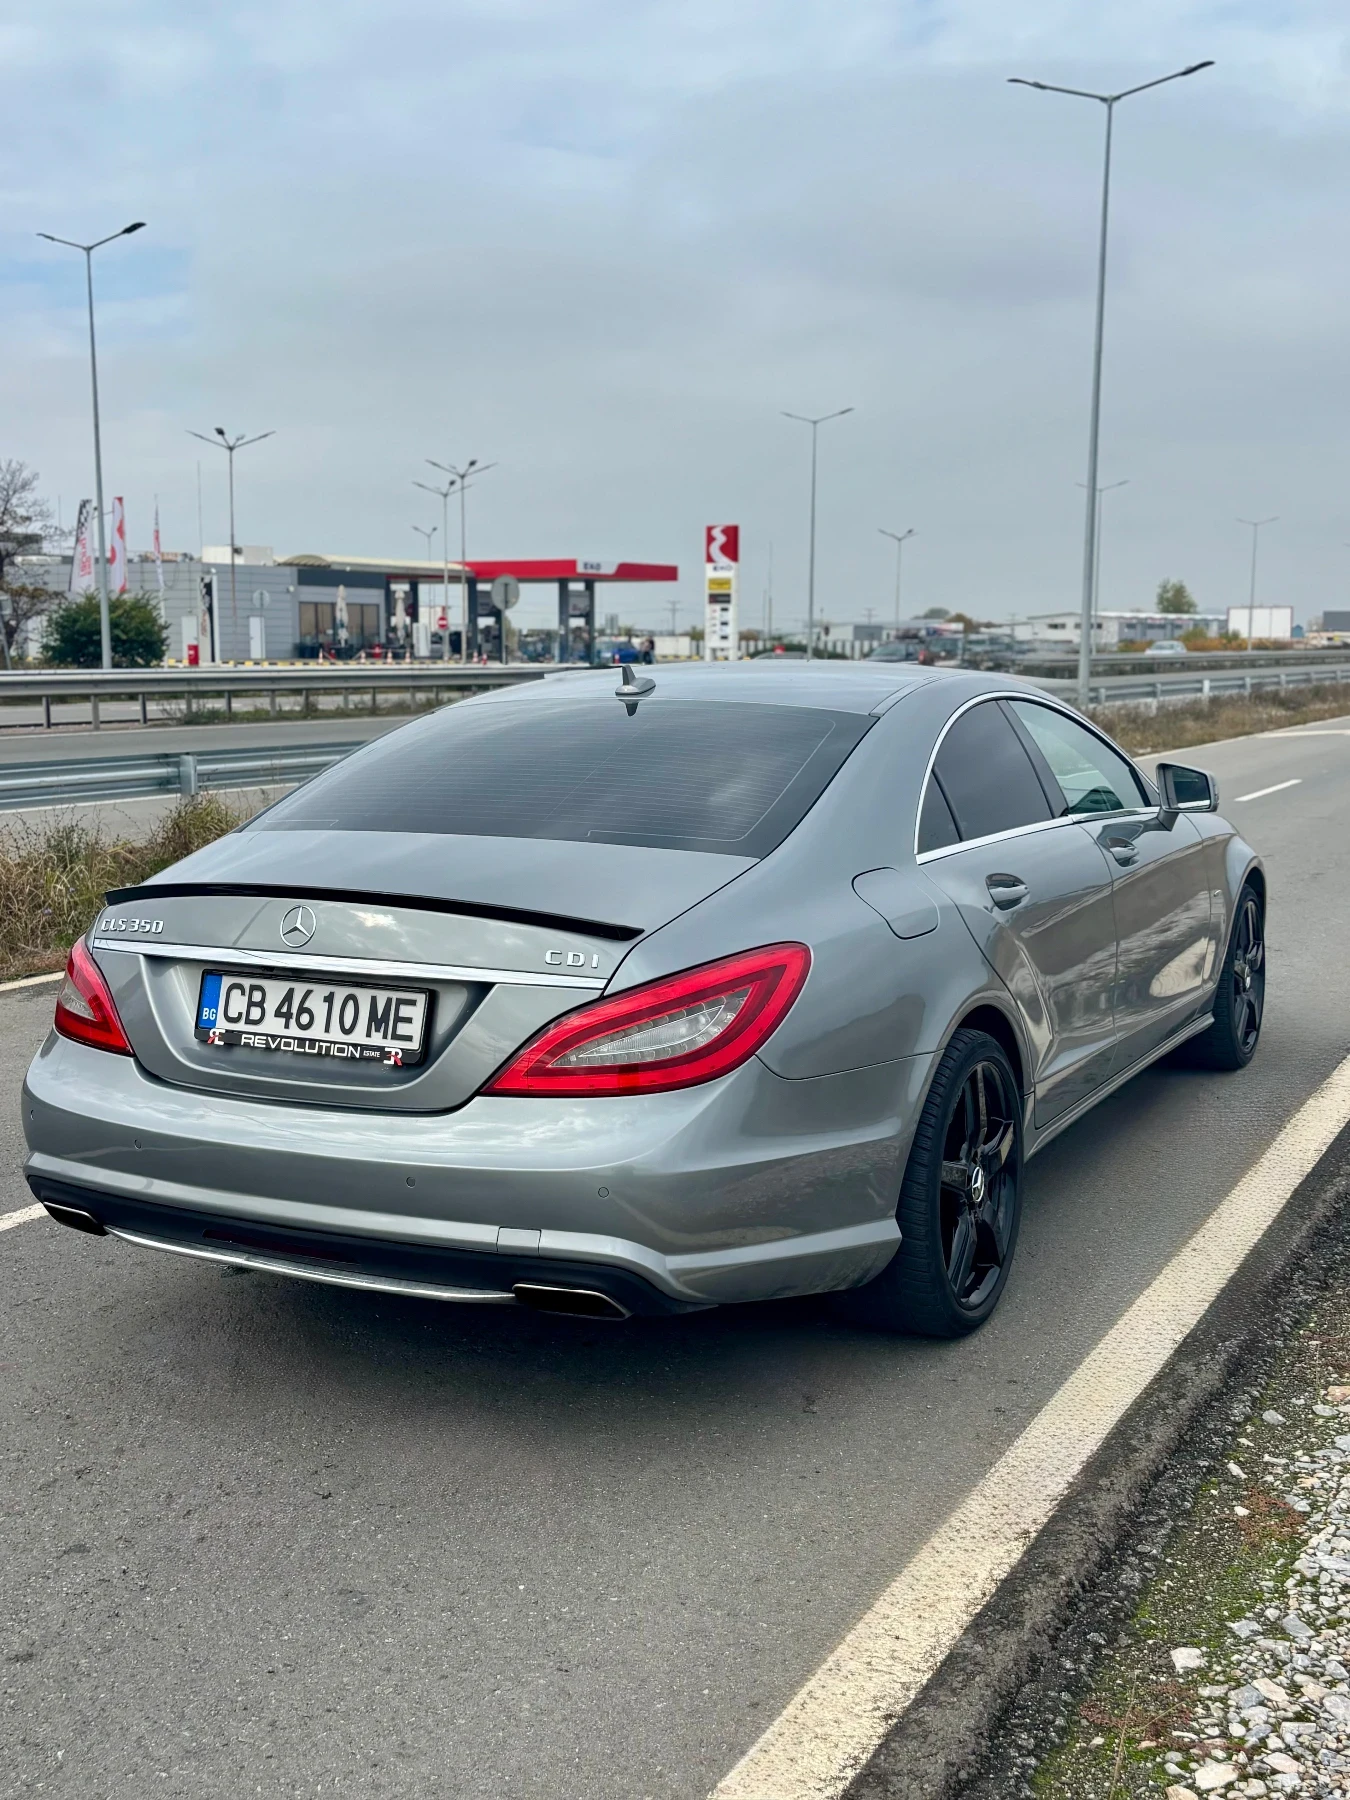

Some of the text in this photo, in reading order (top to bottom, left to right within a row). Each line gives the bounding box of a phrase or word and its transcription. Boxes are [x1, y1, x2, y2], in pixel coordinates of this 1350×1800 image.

[545, 949, 599, 969] CDI
[202, 1007, 217, 1020] BG
[223, 982, 418, 1042] CB 4610 ME
[241, 1034, 361, 1058] REVOLUTION
